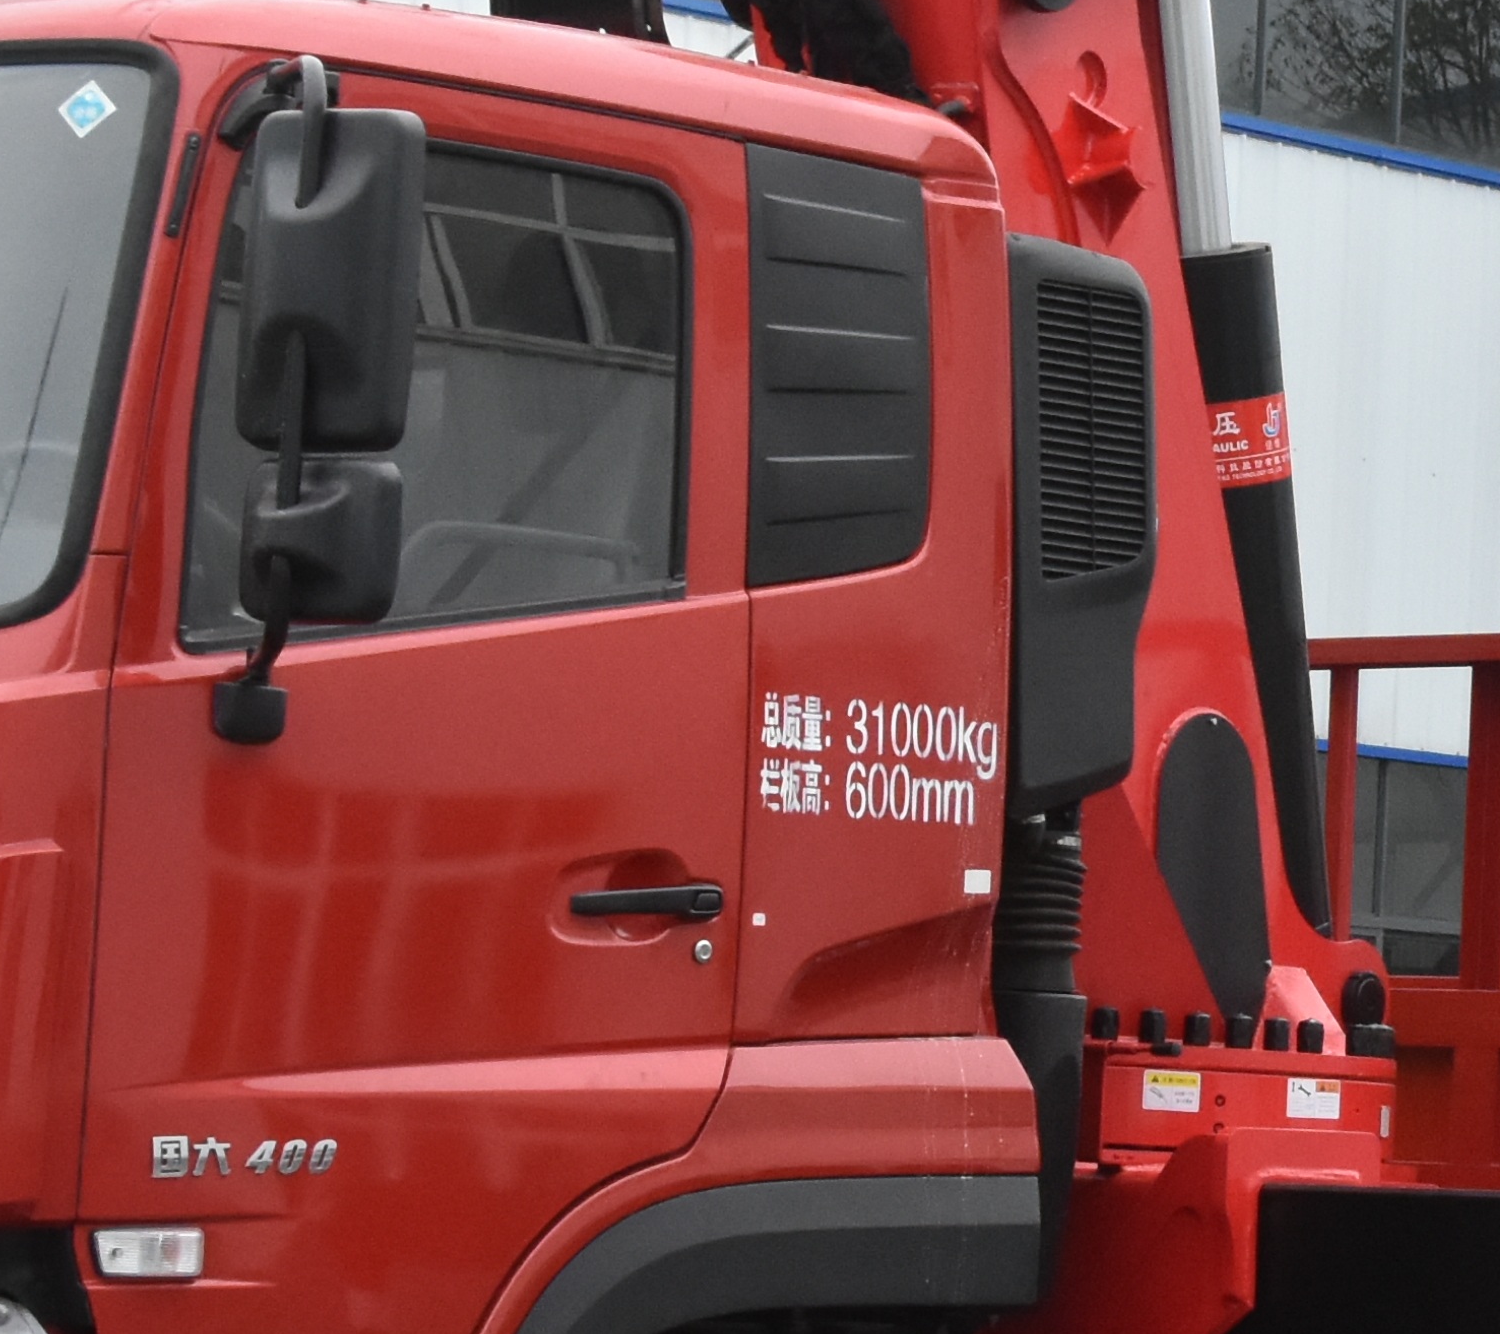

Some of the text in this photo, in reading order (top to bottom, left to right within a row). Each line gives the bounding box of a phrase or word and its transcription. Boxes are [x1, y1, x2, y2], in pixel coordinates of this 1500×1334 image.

[846, 698, 997, 780] 31000kg
[846, 761, 975, 825] 600mm
[152, 1135, 338, 1178] 国六 400
